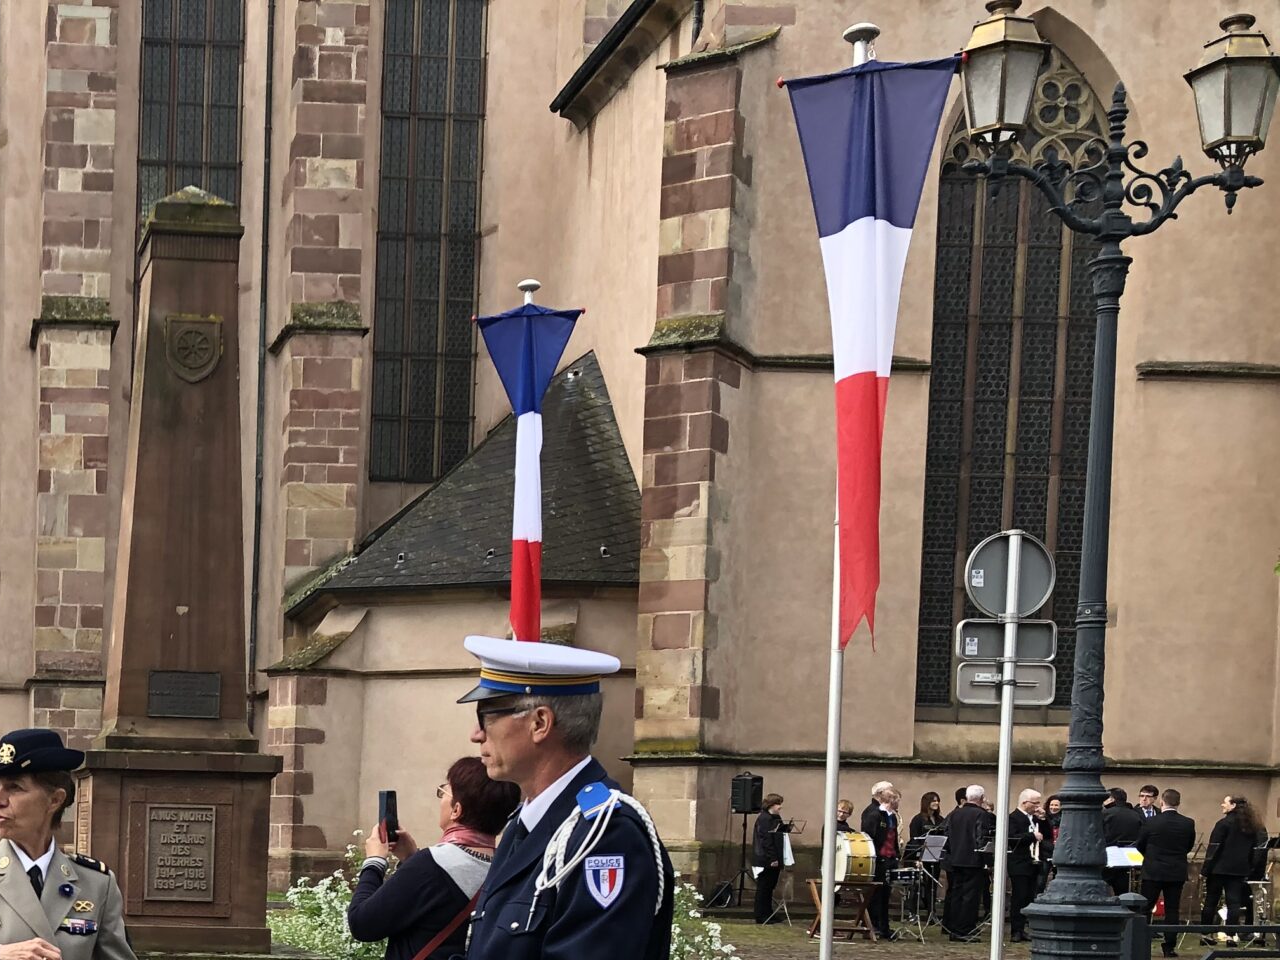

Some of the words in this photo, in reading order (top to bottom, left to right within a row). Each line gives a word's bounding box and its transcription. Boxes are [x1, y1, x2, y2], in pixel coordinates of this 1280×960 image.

[180, 811, 212, 821] MORTS
[175, 824, 189, 833] ET
[160, 834, 206, 845] DISPARUS
[171, 846, 190, 855] DES
[157, 856, 204, 867] GUERRES
